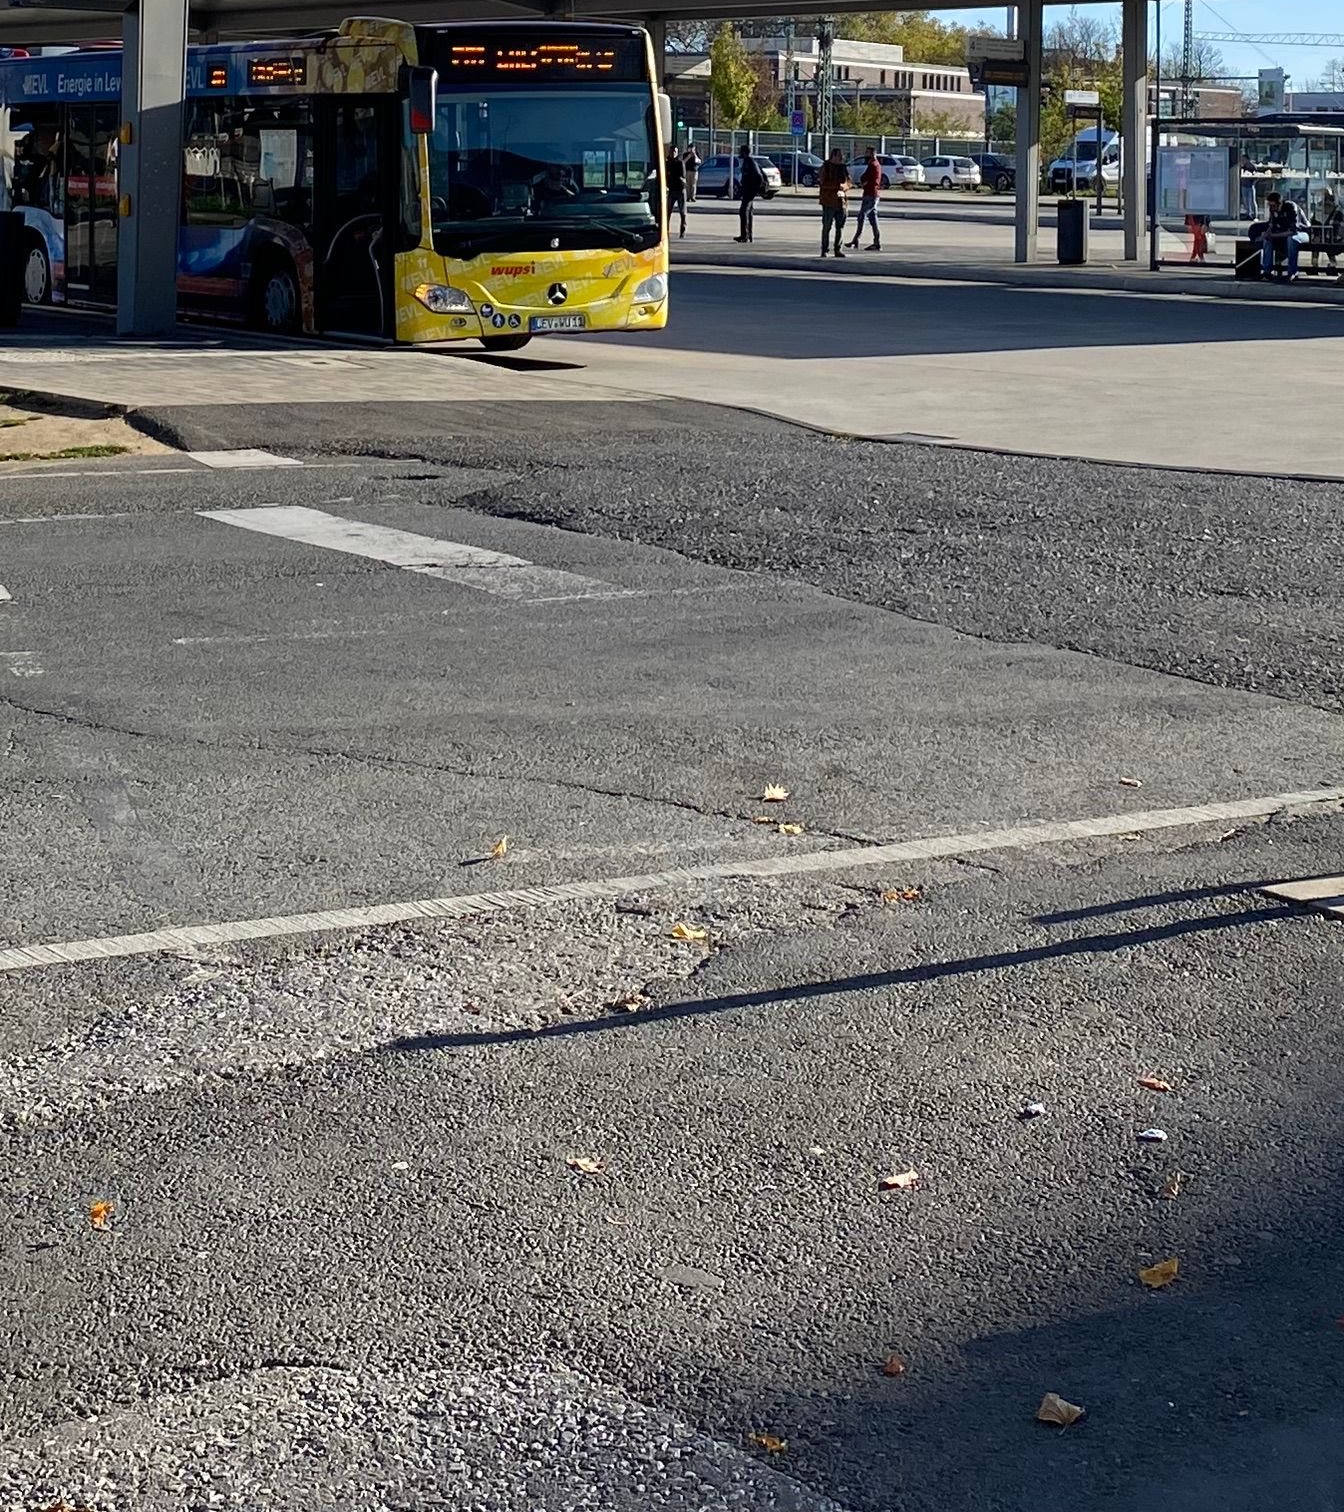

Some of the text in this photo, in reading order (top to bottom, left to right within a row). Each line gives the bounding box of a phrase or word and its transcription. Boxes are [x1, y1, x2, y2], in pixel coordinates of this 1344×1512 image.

[970, 40, 976, 50] 4
[58, 74, 92, 96] Energie
[94, 73, 103, 92] in
[491, 261, 536, 278] wupsi
